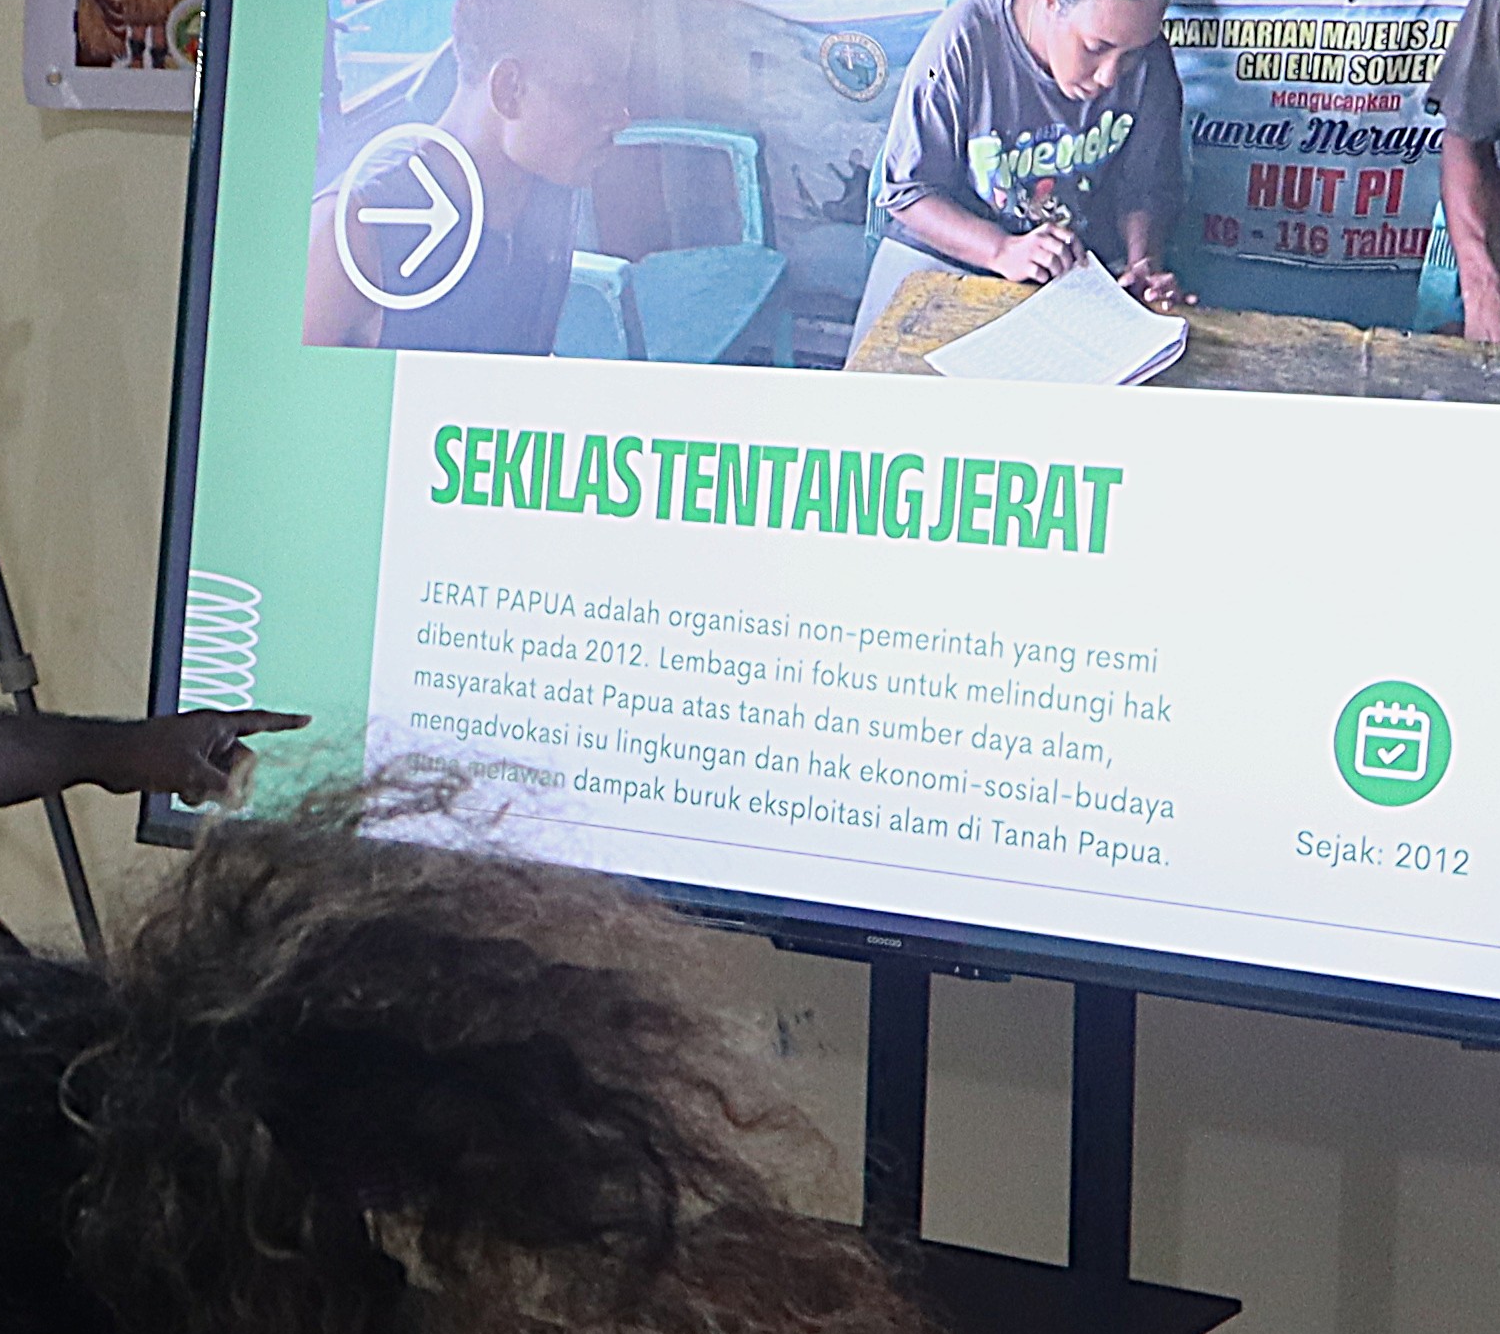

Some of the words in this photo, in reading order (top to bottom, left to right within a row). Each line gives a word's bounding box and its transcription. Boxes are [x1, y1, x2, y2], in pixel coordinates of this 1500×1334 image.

[1222, 19, 1318, 49] HARIAN
[1320, 20, 1429, 51] MAJELIS
[1236, 51, 1282, 82] GKI
[1284, 52, 1346, 84] ELIM
[1271, 90, 1401, 114] Mengucapkan
[968, 109, 1134, 204] Friends
[1247, 163, 1346, 216] HUT
[1354, 167, 1405, 218] PI
[1275, 221, 1329, 258] 116
[430, 423, 644, 519] SEKILAS
[650, 437, 924, 539] TENTANG
[927, 454, 1124, 556] JERAT
[417, 622, 513, 654] dibentuk
[521, 635, 577, 662] pada
[585, 639, 649, 668] 2012.
[660, 647, 766, 686] Lembaga
[775, 657, 802, 684] ini
[813, 660, 878, 691] fokus
[887, 673, 957, 700] untuk
[967, 679, 1115, 723] melindungi
[1124, 691, 1172, 722] hak
[420, 580, 489, 608] JERAT
[496, 588, 575, 617] PAPUA
[584, 596, 660, 625] adalah
[669, 609, 790, 638] organisasi
[799, 619, 1004, 659] non-pemerintah
[1013, 641, 1076, 672] yang
[1086, 648, 1158, 673] resmi
[414, 669, 536, 699] masyarakat
[544, 679, 594, 706] adat
[602, 685, 674, 717] Papua
[682, 696, 730, 721] atas
[739, 701, 805, 729] tanah
[814, 706, 859, 736] dan
[868, 717, 964, 747] sumber
[971, 723, 1032, 760] daya
[1042, 731, 1113, 769] alam,
[410, 711, 569, 746] mengadvokasi
[576, 724, 608, 752] isu
[616, 728, 746, 770] lingkungan
[755, 745, 799, 773] dan
[808, 750, 851, 780] hak
[859, 758, 1175, 825] ekonomi-sosial-budaya
[468, 756, 566, 788] melawan
[573, 768, 666, 802] dampak
[673, 779, 740, 811] buruk
[749, 789, 881, 828] eksploitasi
[889, 807, 948, 837] alam
[957, 815, 981, 841] di
[992, 820, 1067, 852] Tanah
[1079, 831, 1169, 867] Papua.
[1295, 830, 1383, 869] Sejak:
[1395, 842, 1470, 876] 2012
